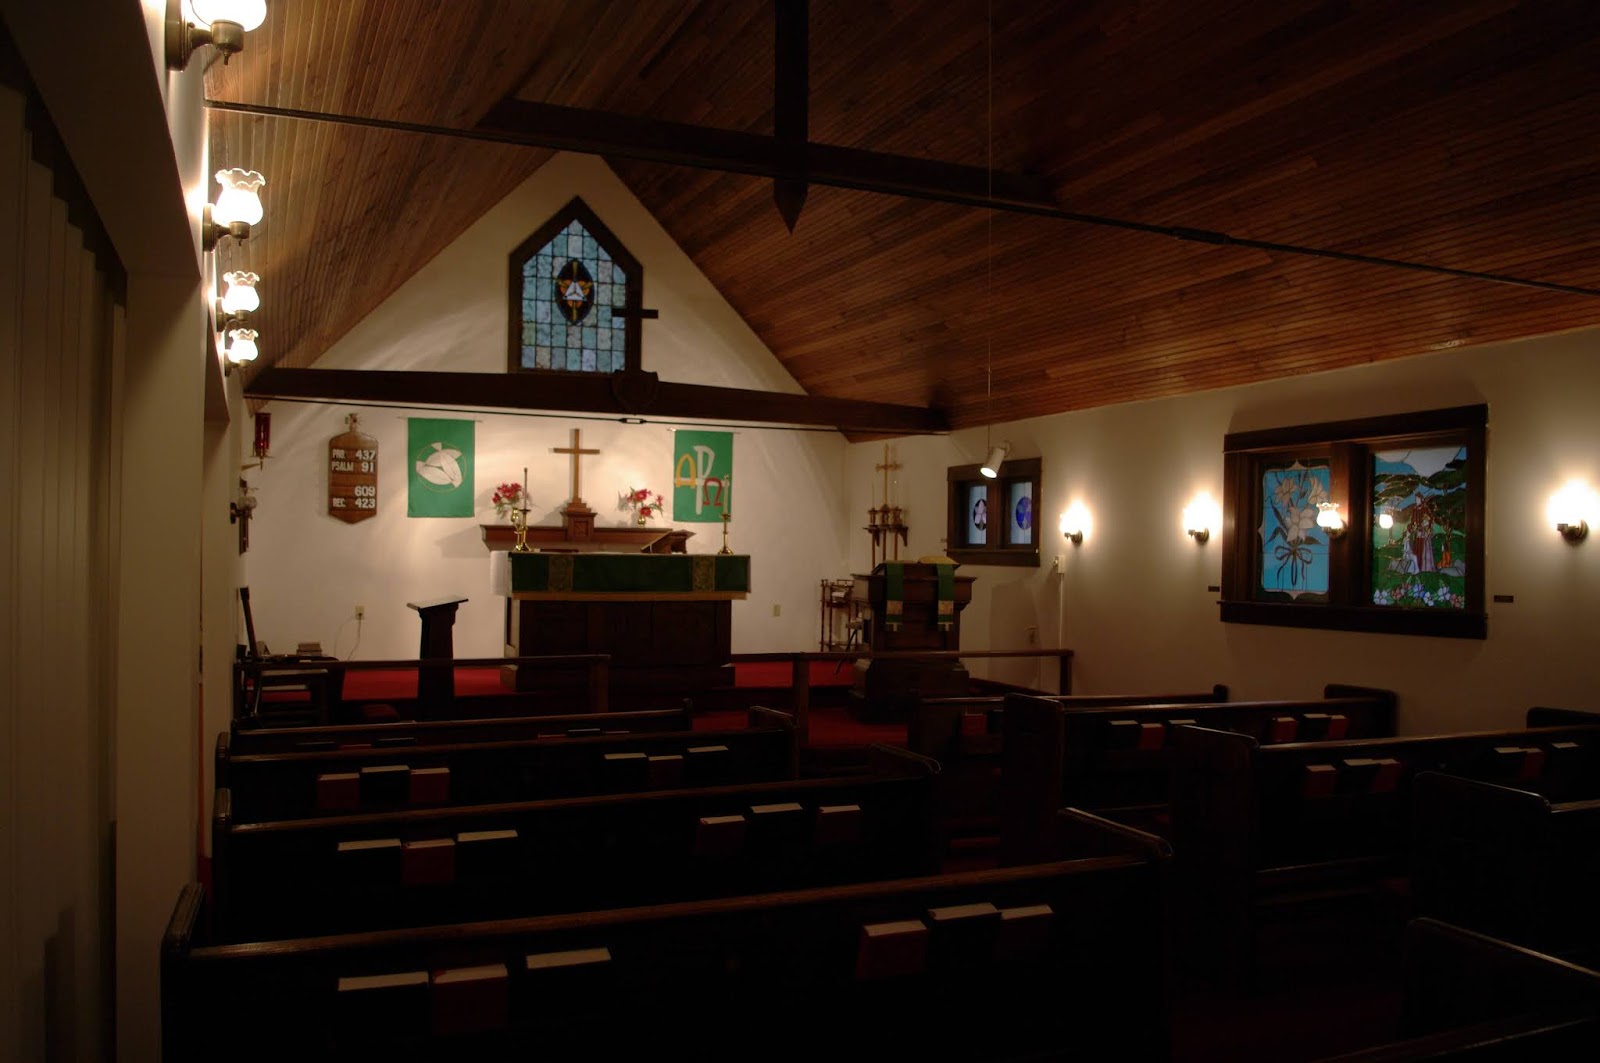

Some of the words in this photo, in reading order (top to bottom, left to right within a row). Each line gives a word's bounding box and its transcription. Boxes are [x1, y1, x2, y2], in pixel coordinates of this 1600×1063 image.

[355, 450, 376, 460] 437
[332, 462, 354, 472] PSALM
[362, 462, 374, 472] 91
[354, 486, 376, 496] 609
[355, 498, 376, 508] 423
